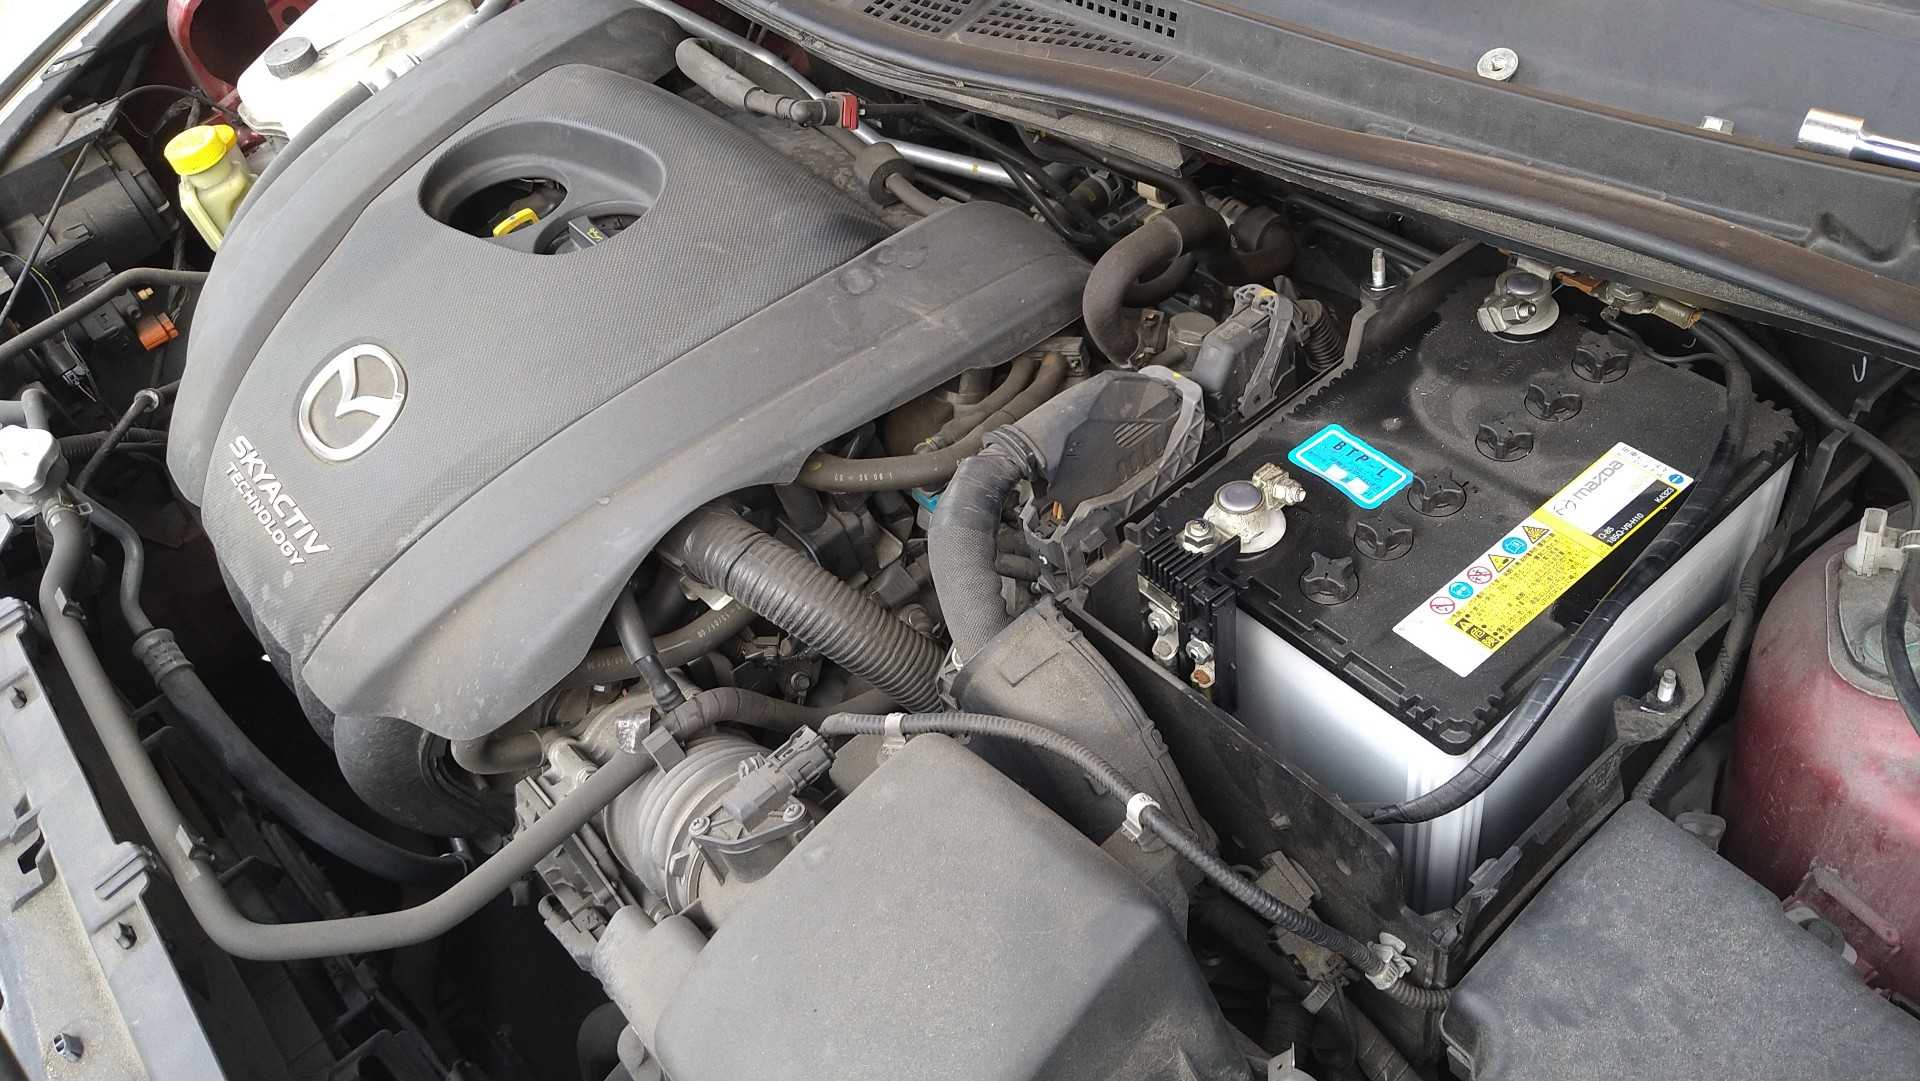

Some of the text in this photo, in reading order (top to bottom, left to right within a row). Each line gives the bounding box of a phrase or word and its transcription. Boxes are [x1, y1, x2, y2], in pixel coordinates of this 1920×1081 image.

[226, 461, 305, 565] TECHNOLOGY
[229, 435, 331, 553] SKYACTIV
[1598, 526, 1615, 540] Q-85
